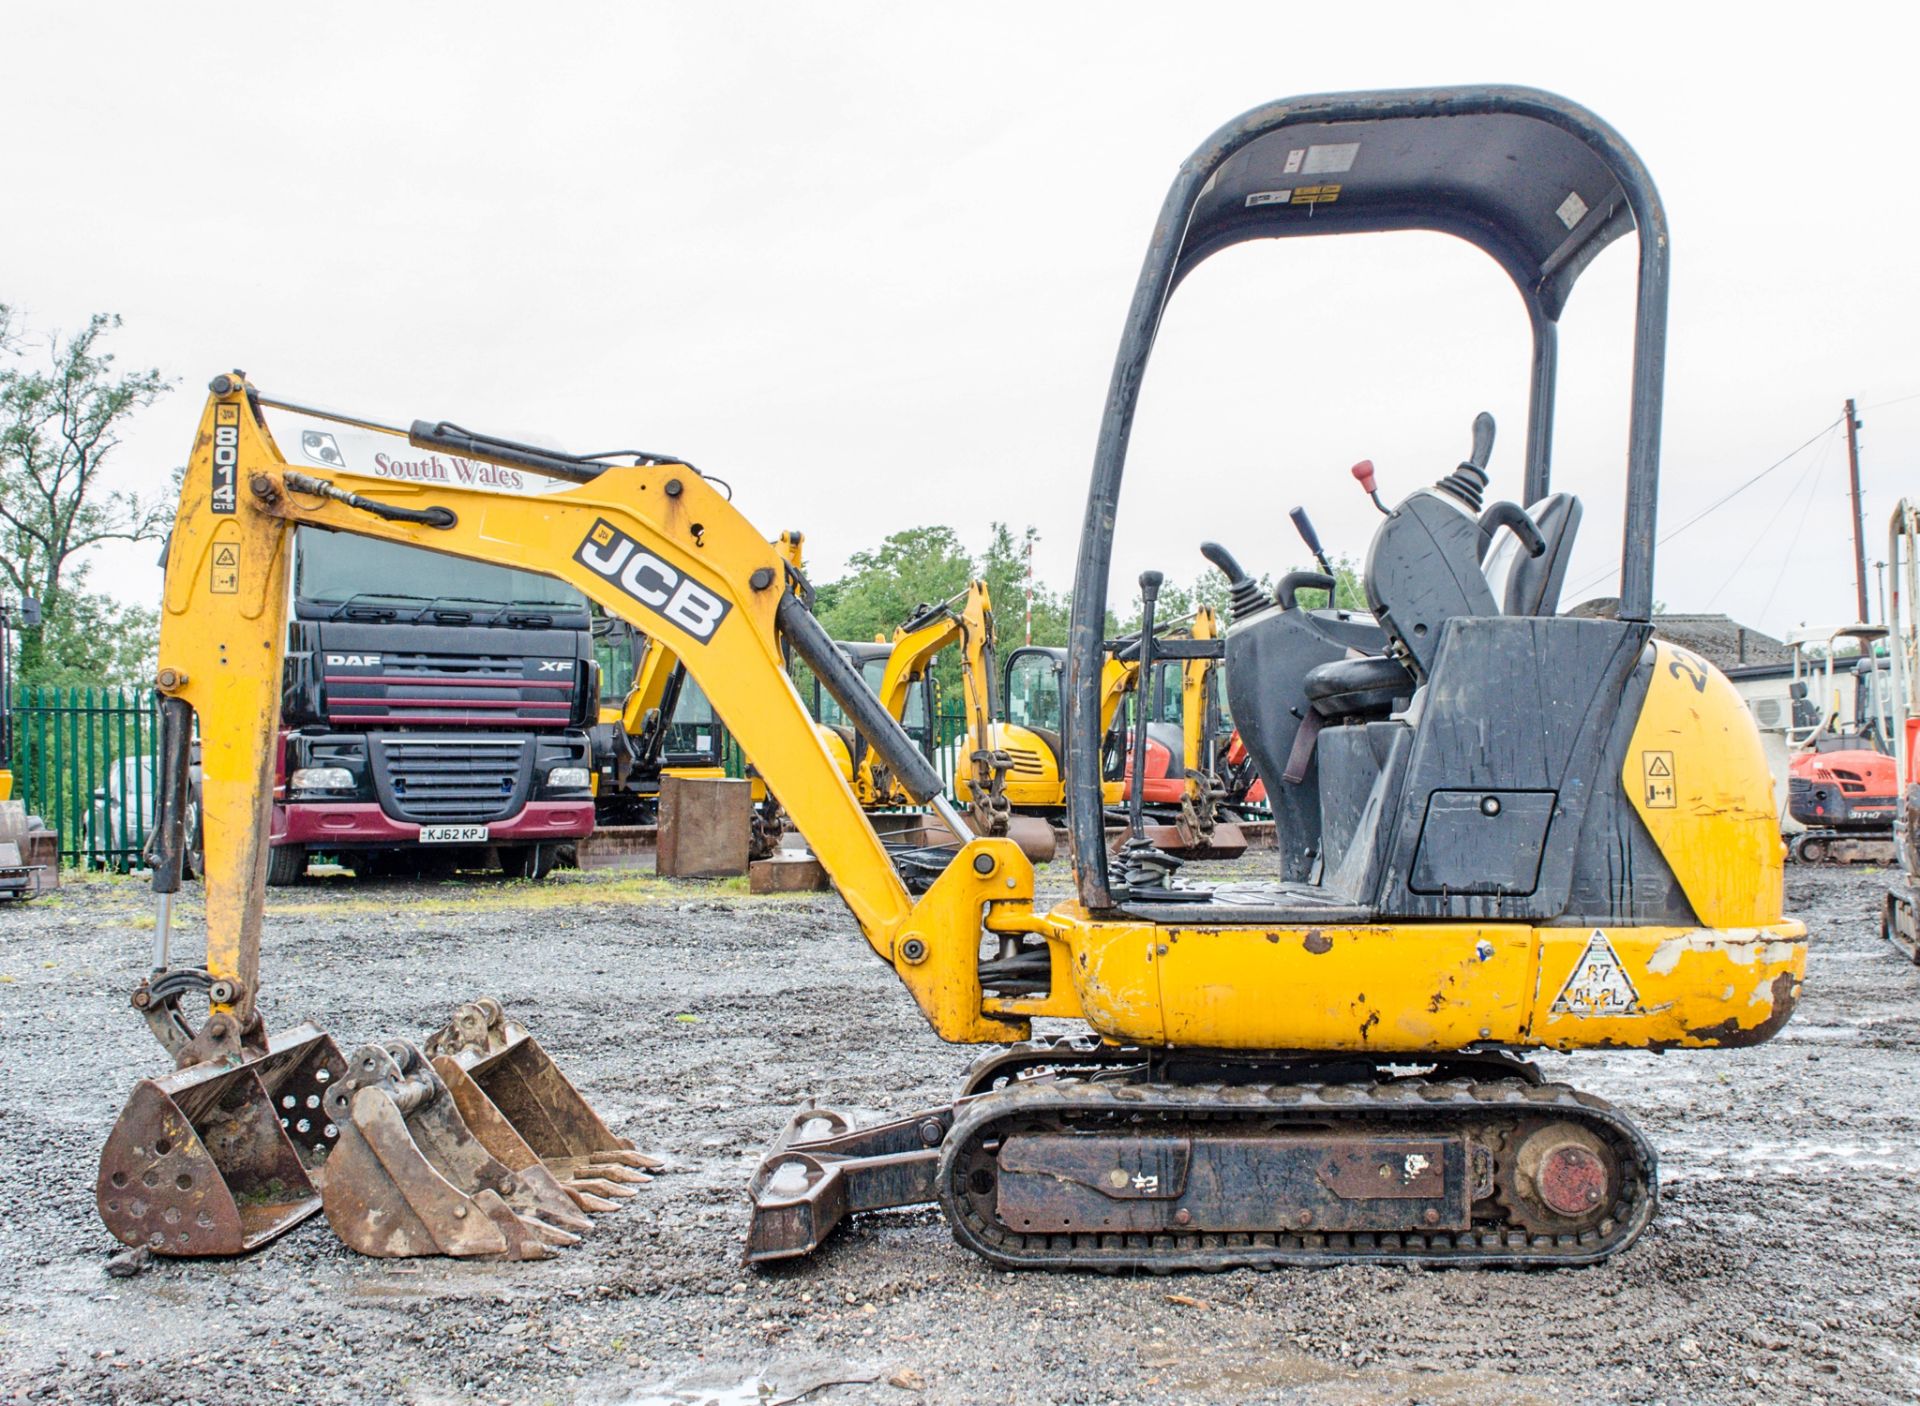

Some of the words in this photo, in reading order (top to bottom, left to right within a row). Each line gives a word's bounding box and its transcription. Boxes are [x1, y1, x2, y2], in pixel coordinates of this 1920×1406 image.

[213, 427, 237, 503] 8014
[375, 452, 449, 482] South
[450, 457, 524, 489] Wales
[581, 538, 724, 637] JCB
[326, 655, 381, 667] DAF
[538, 661, 573, 672] XF
[427, 829, 460, 840] KJ62
[462, 829, 487, 840] KPJ
